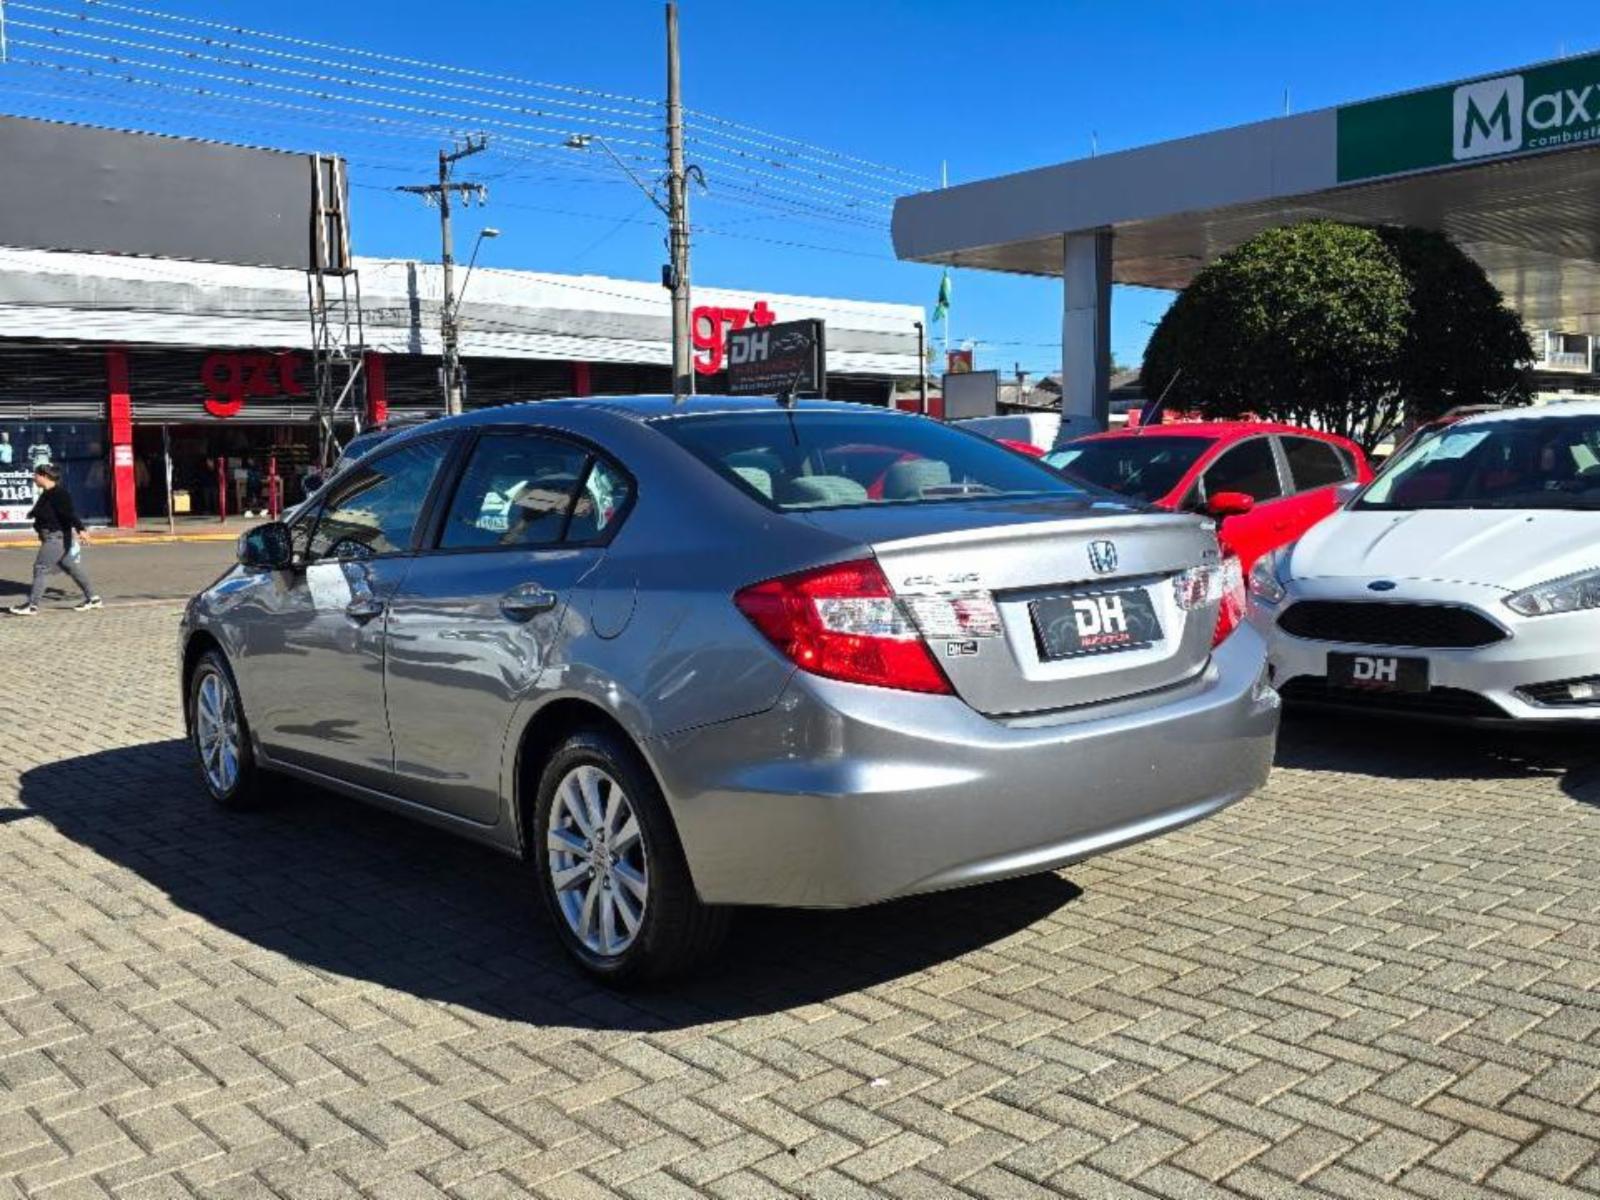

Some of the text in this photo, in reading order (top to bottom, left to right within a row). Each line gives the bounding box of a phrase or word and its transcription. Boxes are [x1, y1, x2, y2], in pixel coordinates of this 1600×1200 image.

[1463, 83, 1600, 149] Max
[730, 331, 770, 364] DH
[1072, 596, 1127, 636] DH
[1353, 656, 1398, 682] DH
